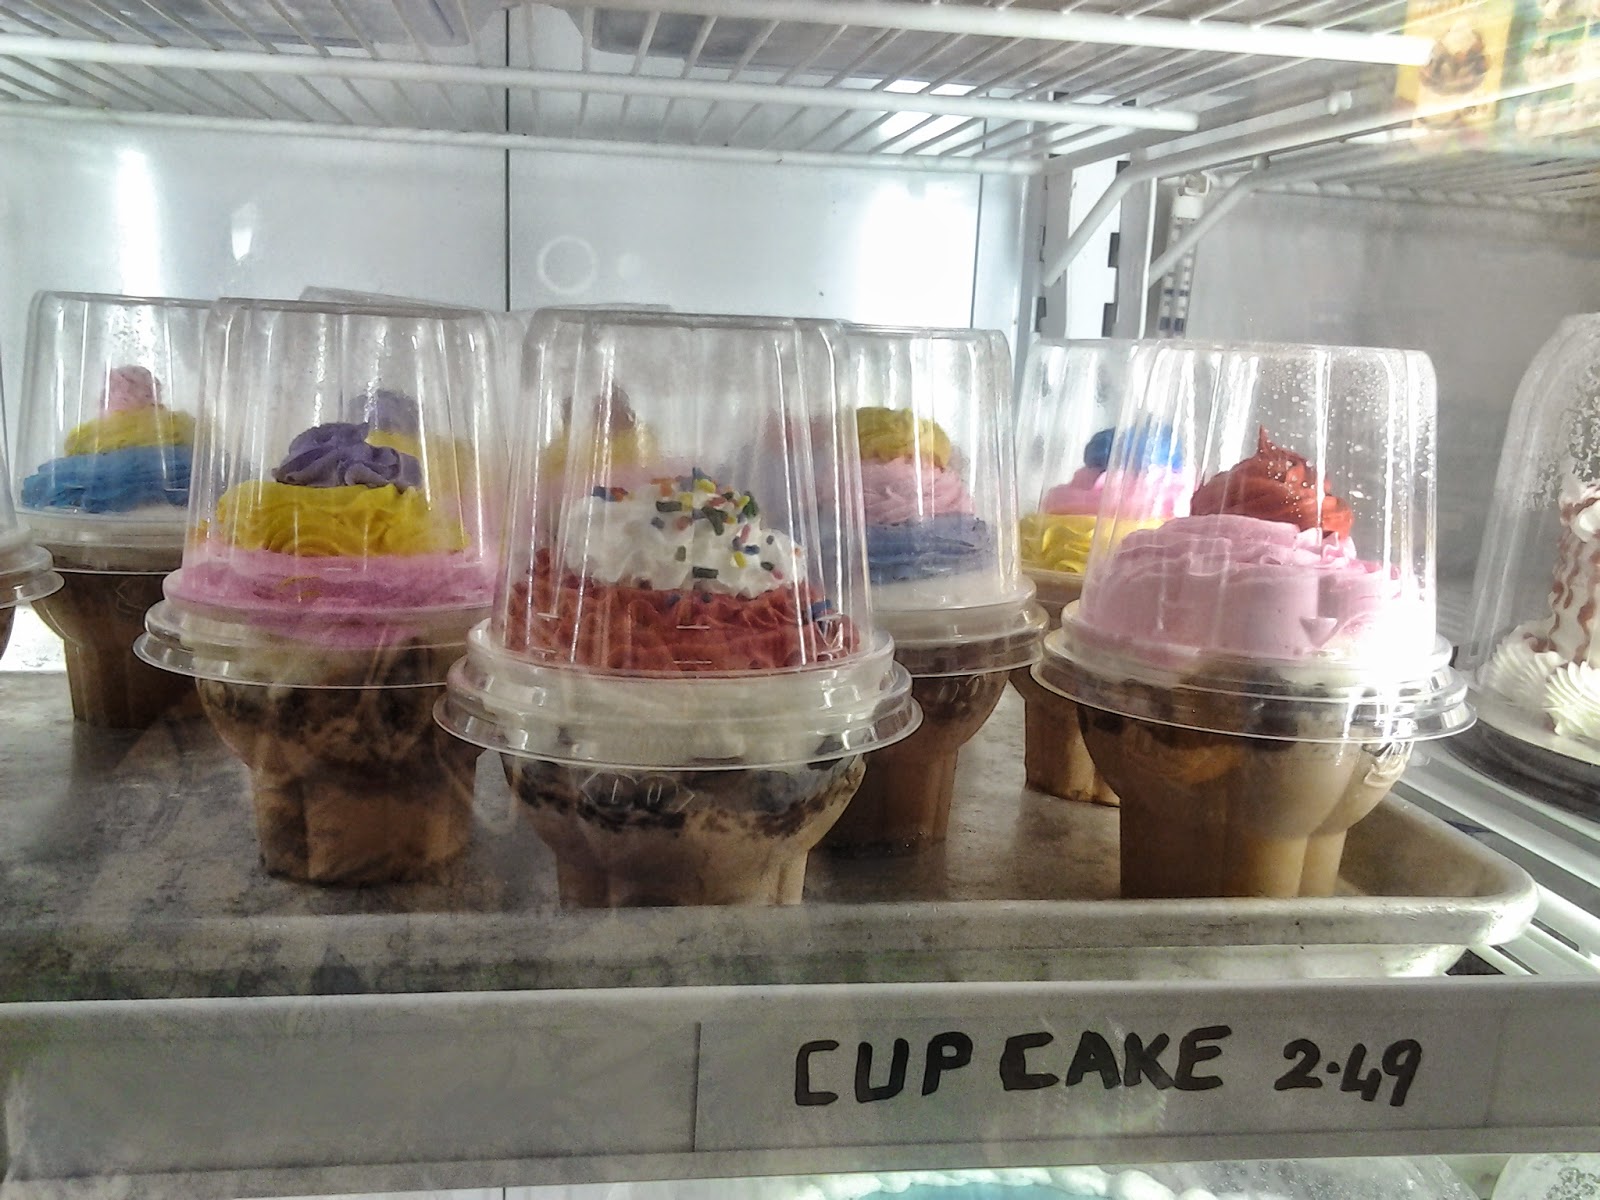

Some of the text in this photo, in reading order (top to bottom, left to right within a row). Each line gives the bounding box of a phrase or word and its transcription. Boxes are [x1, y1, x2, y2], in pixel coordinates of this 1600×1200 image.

[793, 1025, 1425, 1108] CUP CAKE 2.49
